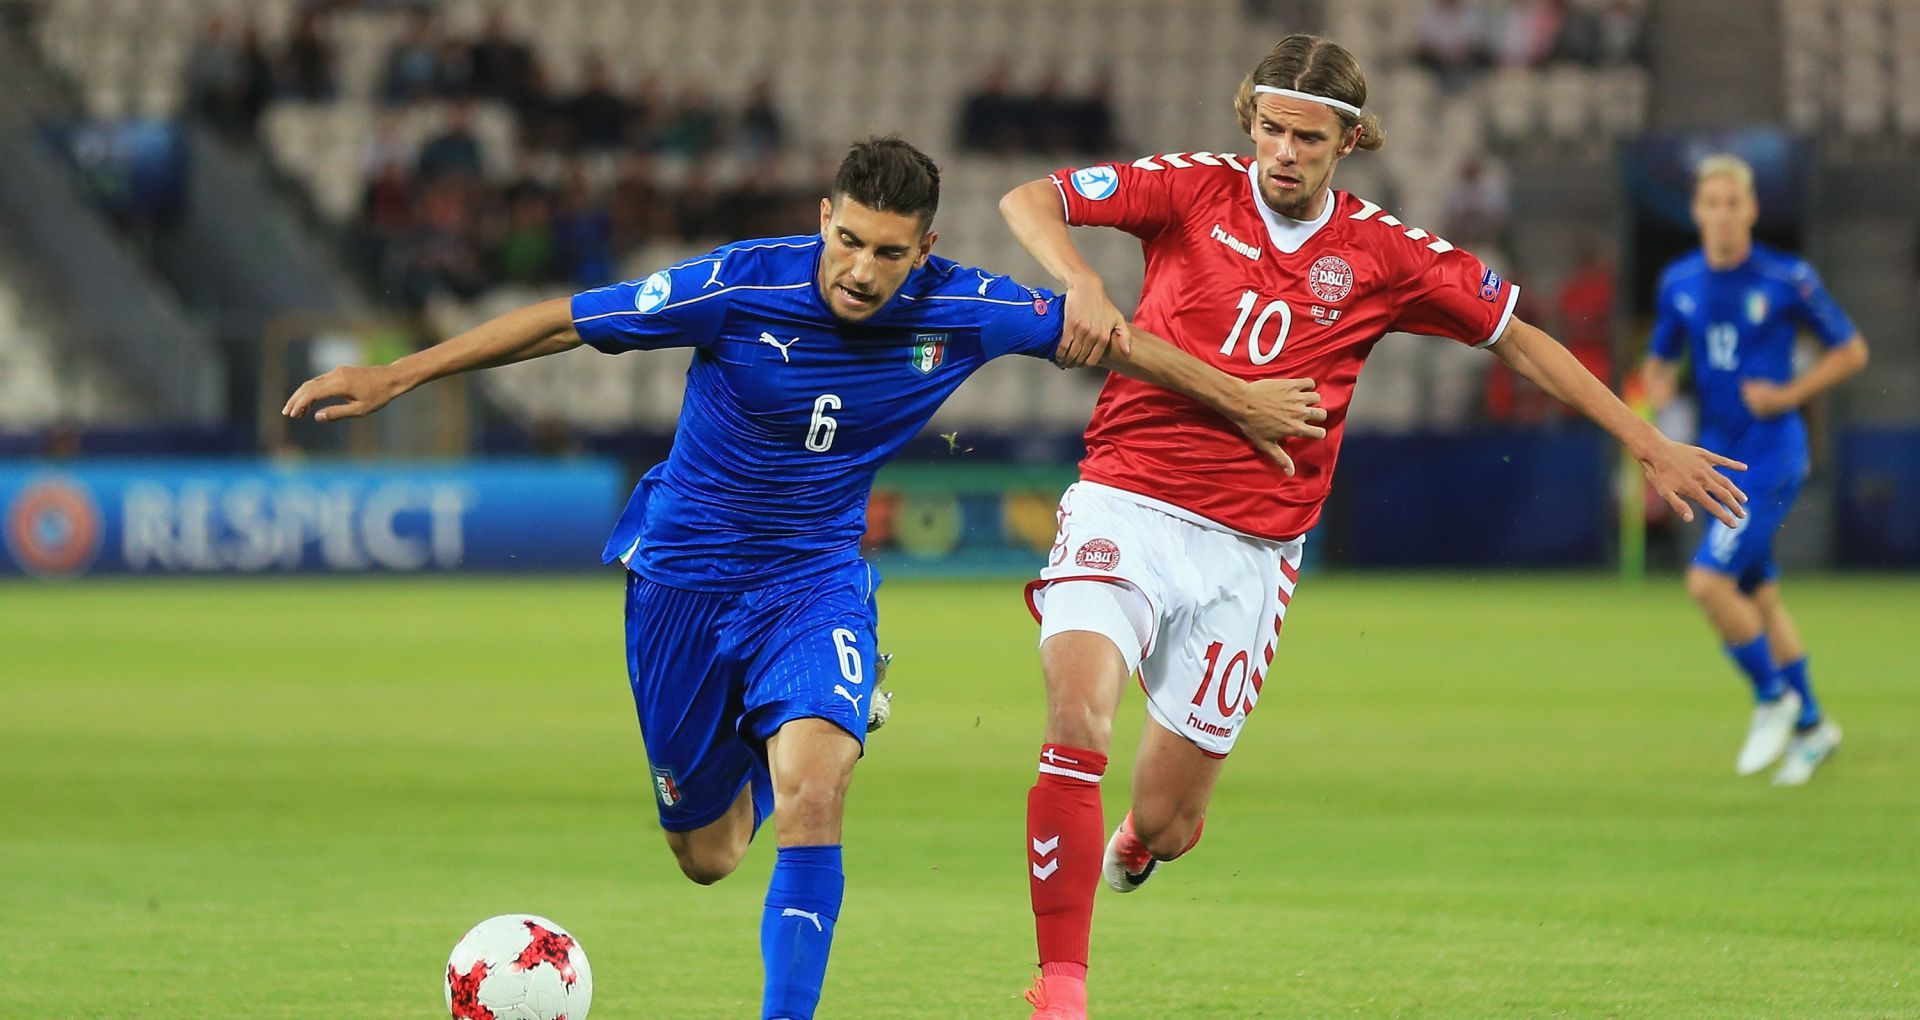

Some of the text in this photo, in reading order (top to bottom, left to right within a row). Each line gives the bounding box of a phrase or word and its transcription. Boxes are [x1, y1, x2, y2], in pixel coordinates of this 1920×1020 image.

[1210, 225, 1261, 260] hummel
[1319, 270, 1345, 286] DBU
[1218, 289, 1292, 366] 10
[804, 394, 842, 453] 6
[122, 478, 472, 569] RESPECT
[1085, 551, 1112, 563] DBU
[831, 627, 863, 685] 6
[1191, 640, 1248, 718] 10
[1187, 712, 1234, 737] hummel
